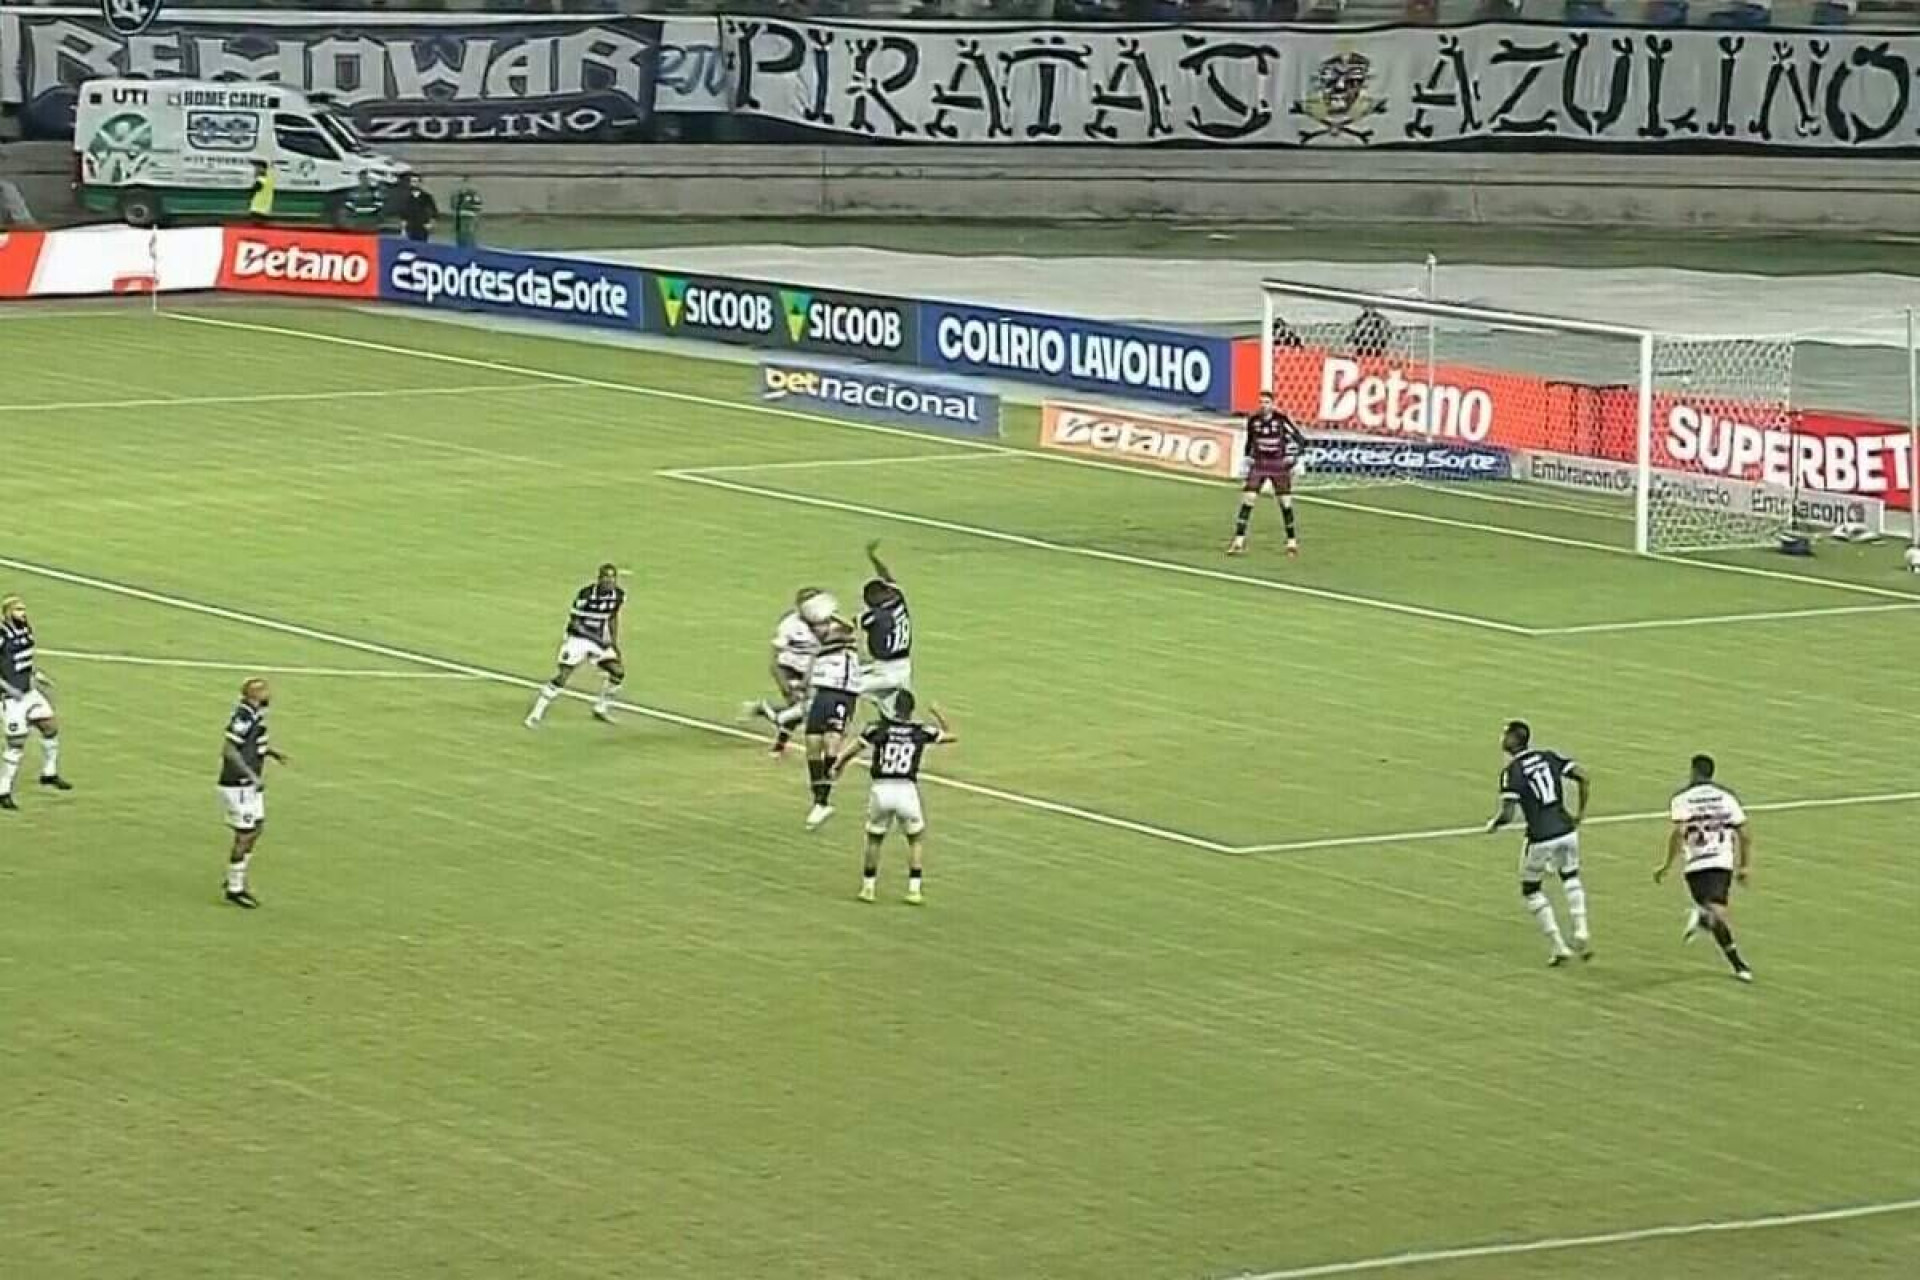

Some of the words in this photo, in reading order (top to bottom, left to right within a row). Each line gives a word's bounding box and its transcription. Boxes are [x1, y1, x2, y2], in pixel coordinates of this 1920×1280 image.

[30, 20, 651, 104] REMOWAR
[728, 20, 1280, 139] PIRATAS
[1405, 34, 1919, 144] AZULINO
[113, 89, 148, 104] UTI
[184, 91, 227, 106] HOME
[229, 92, 267, 108] CARE
[234, 240, 369, 283] Betano
[685, 287, 772, 331] SICOOB
[809, 303, 901, 347] SICOOB
[938, 307, 1065, 373] COLÍRIO
[1070, 332, 1211, 394] LAVOLHO
[763, 367, 980, 422] betnacional
[1319, 356, 1494, 442] Betano
[1055, 411, 1218, 467] Betano
[1665, 404, 1911, 493] SUPERBET
[1532, 456, 1612, 491] Embracon
[881, 742, 916, 775] 98
